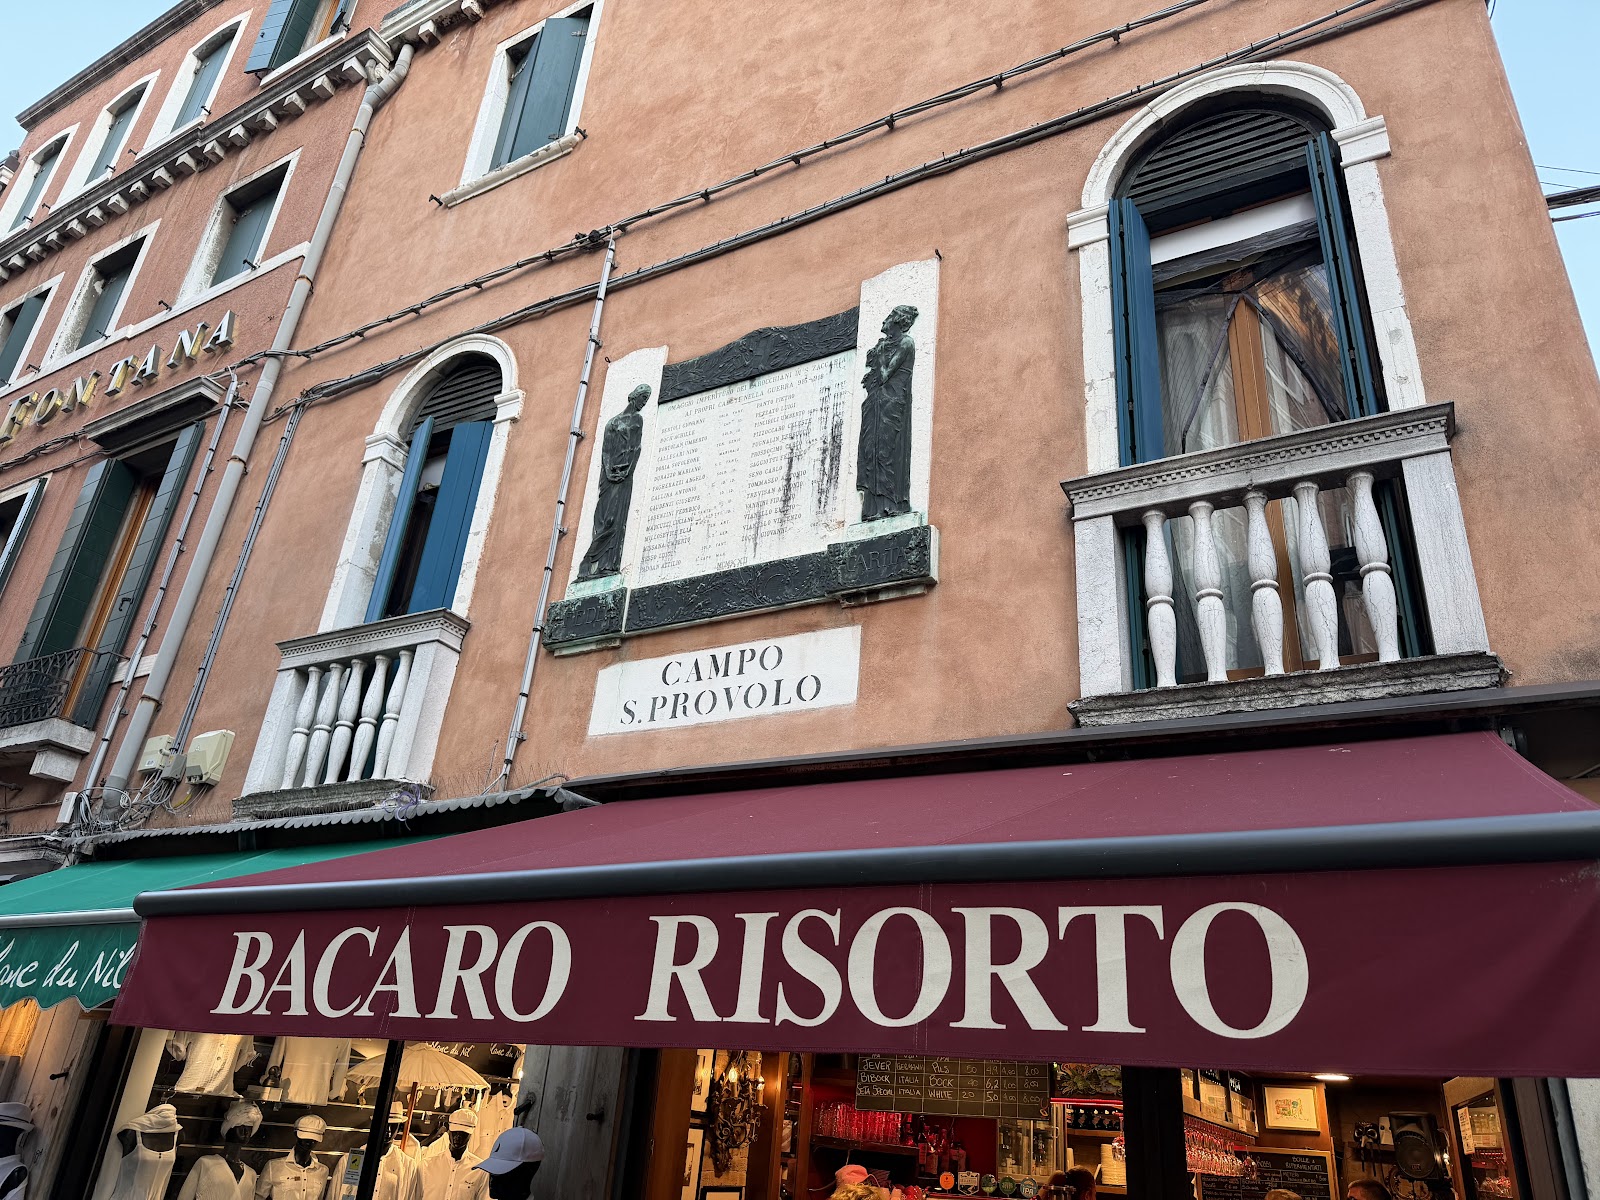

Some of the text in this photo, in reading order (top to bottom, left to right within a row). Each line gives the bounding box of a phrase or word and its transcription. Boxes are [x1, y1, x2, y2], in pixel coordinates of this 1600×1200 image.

[0, 310, 236, 443] FONTANA
[736, 384, 747, 392] DEI
[743, 390, 763, 400] NELLA
[767, 381, 793, 394] GUERRA
[661, 645, 783, 686] CAMPO
[41, 940, 79, 988] du
[80, 941, 138, 992] Nil
[210, 901, 1309, 1038] BACARO RISORTO
[862, 1059, 892, 1071] JEVER
[860, 1072, 891, 1084] BIBOCK
[898, 1075, 919, 1084] ITALIA
[929, 1074, 955, 1088] BOCK
[928, 1088, 953, 1099] WHITE
